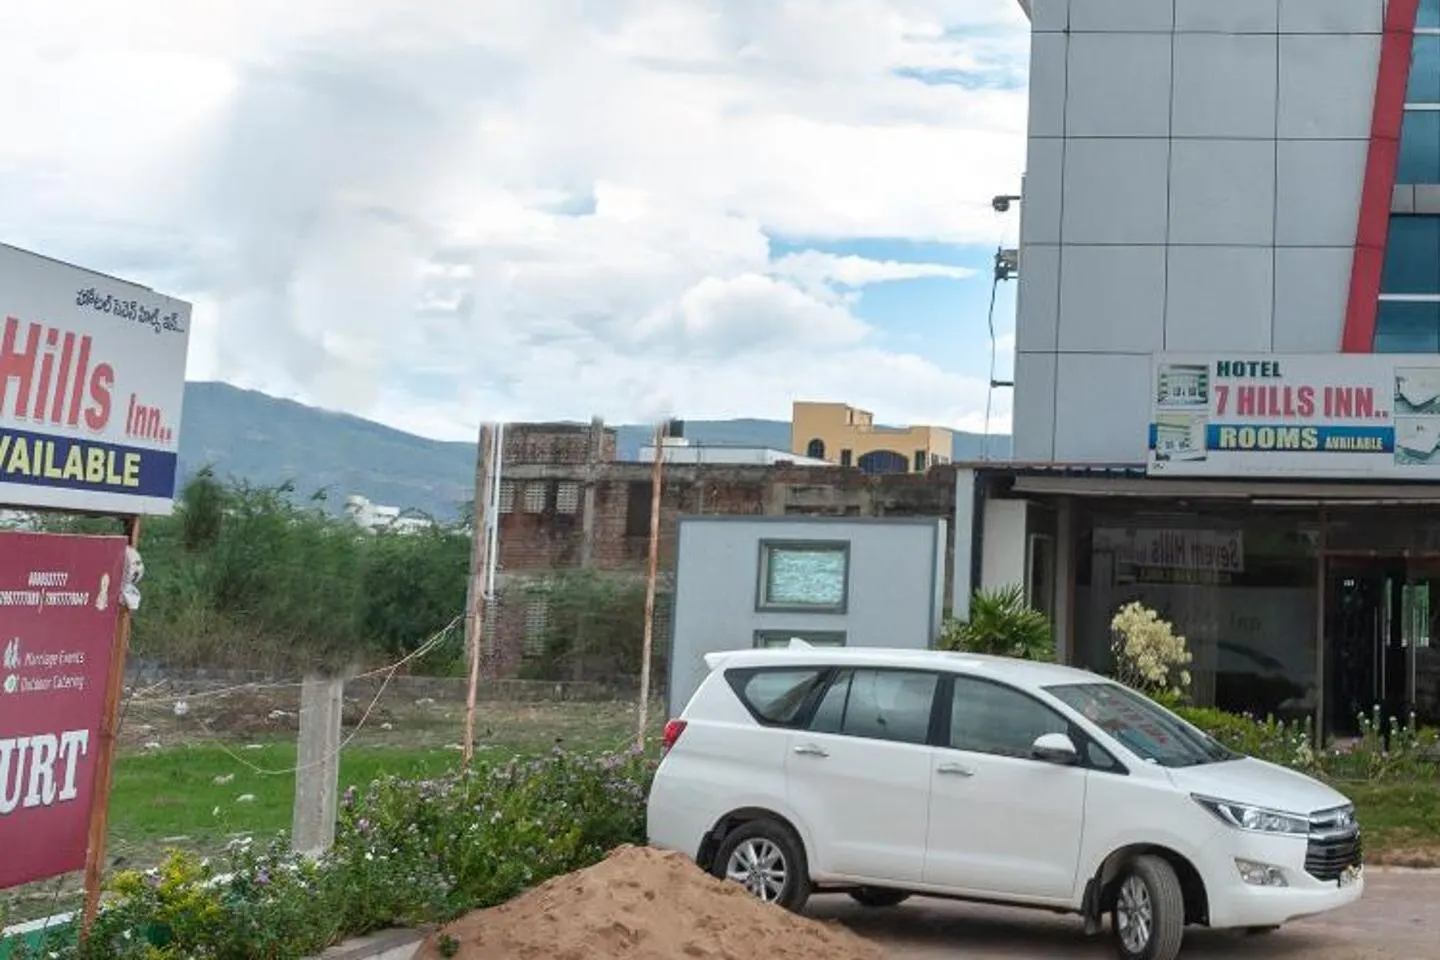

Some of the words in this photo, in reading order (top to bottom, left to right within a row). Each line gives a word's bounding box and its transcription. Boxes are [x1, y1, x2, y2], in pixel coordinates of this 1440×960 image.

[0, 316, 115, 432] Hills
[1215, 360, 1282, 378] HOTEL
[1214, 385, 1229, 416] 7
[1236, 385, 1315, 418] HILLS
[1219, 426, 1319, 450] ROOMS
[1325, 436, 1383, 451] AVAILABLE
